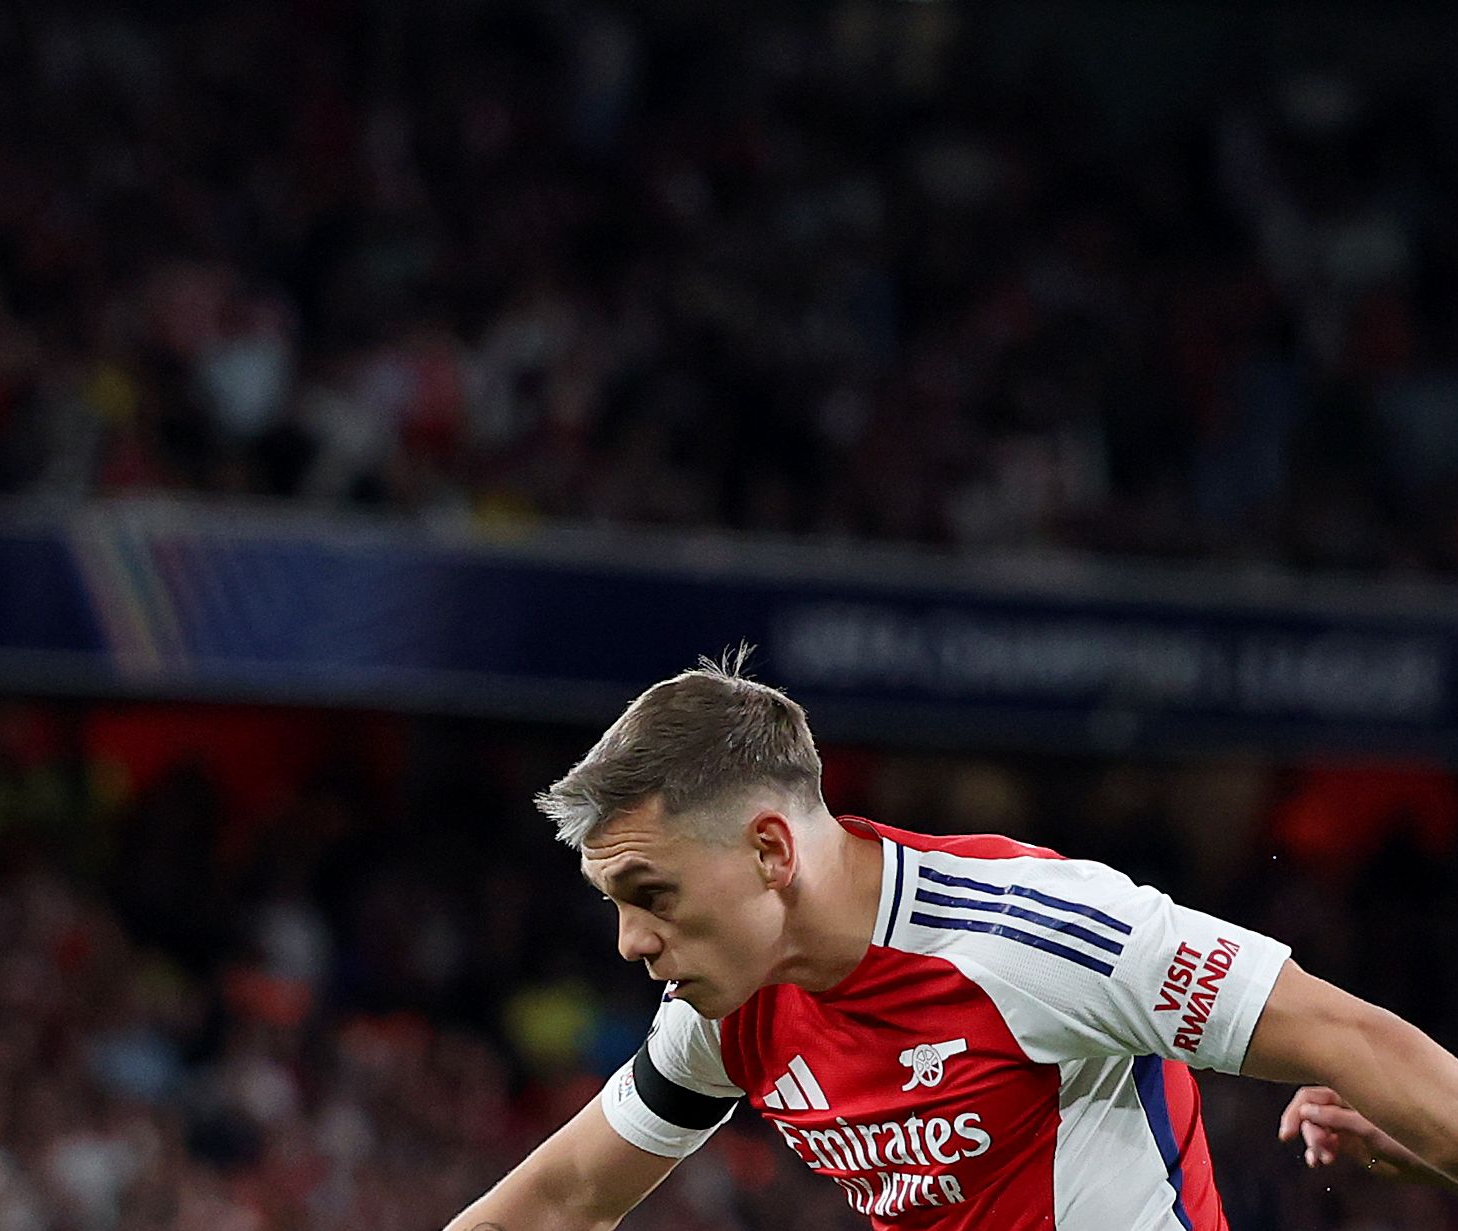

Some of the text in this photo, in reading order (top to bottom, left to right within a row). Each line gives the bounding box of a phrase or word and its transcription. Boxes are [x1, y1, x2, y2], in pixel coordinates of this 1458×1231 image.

[1153, 941, 1202, 1012] VISIT
[1173, 937, 1240, 1053] RWANDA
[773, 1112, 991, 1170] Emirates
